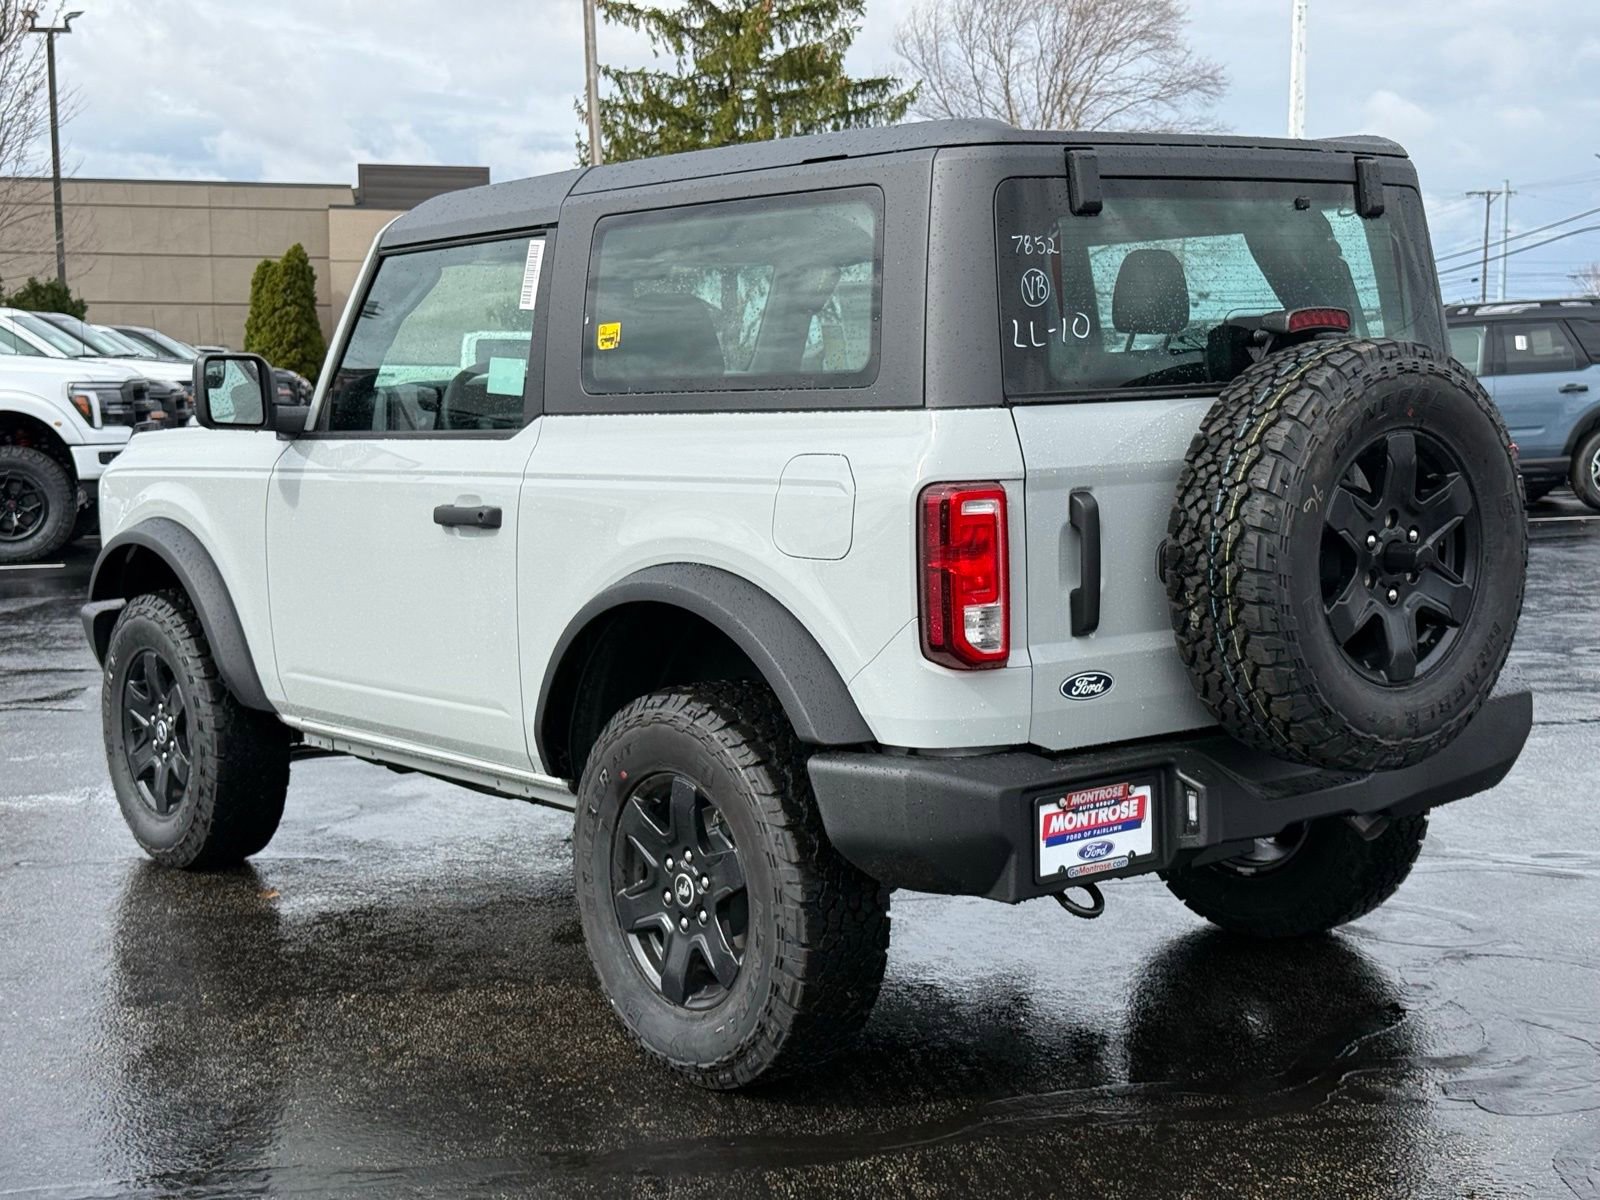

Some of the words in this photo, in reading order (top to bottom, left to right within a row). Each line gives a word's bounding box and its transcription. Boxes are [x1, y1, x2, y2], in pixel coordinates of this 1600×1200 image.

[1011, 234, 1060, 255] 7852
[1022, 275, 1048, 301] VB
[1012, 312, 1090, 348] LL-10
[1071, 676, 1105, 696] Ford
[1070, 785, 1124, 806] MONTROSE
[1079, 803, 1094, 811] AUTO
[1096, 799, 1115, 807] GROUP
[1049, 799, 1139, 834] MONTROSE
[1066, 833, 1082, 841] FORD
[1093, 825, 1122, 836] FAIRLAWN
[1084, 842, 1108, 858] Ford
[1069, 859, 1128, 877] GoMontrose.com
